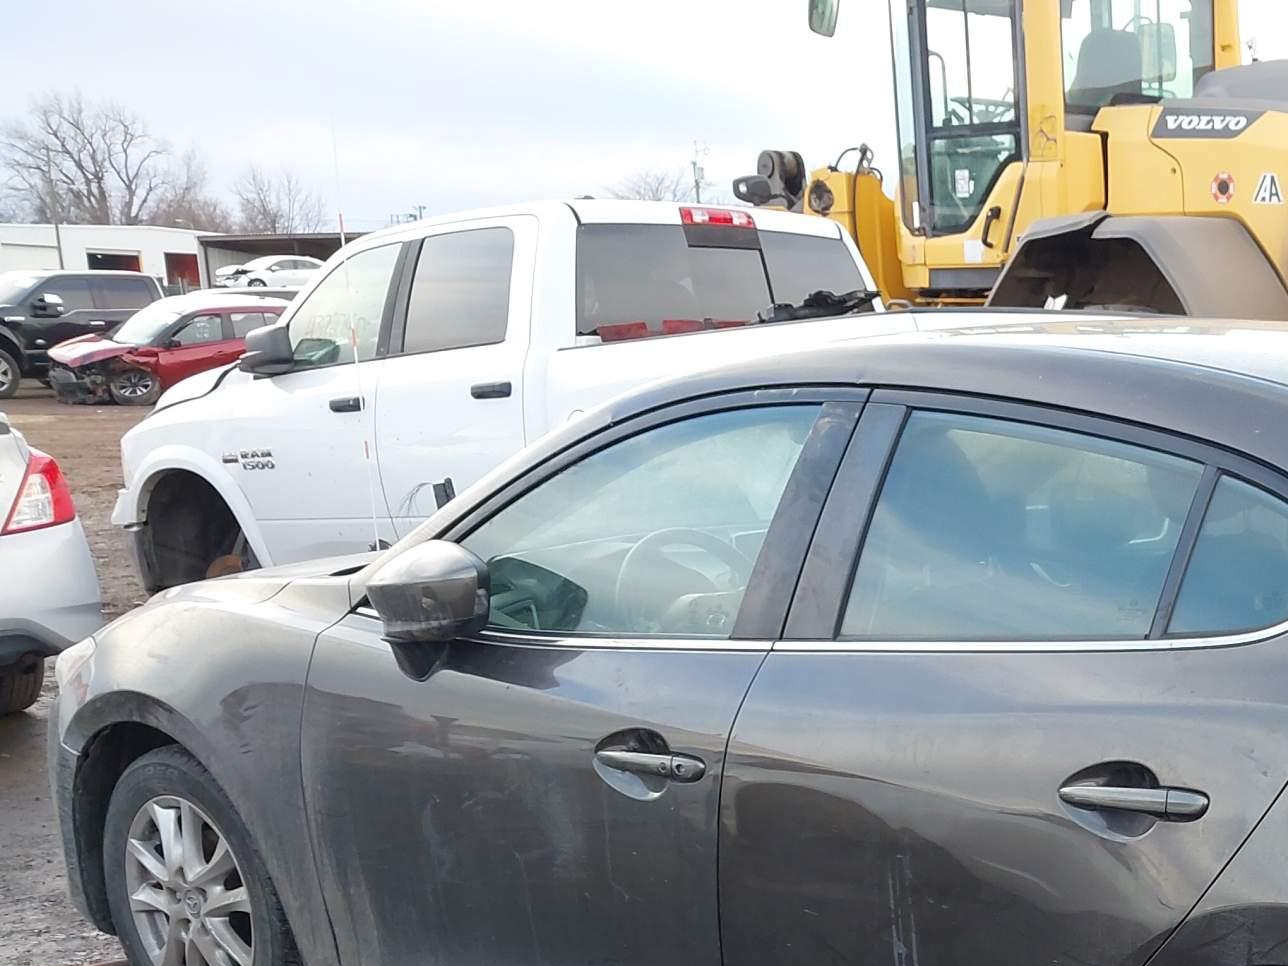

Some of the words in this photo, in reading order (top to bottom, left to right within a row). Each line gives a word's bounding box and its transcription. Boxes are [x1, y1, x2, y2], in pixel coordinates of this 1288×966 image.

[1165, 115, 1248, 130] VOLVO
[240, 450, 273, 459] RAM
[241, 460, 276, 470] 1500
